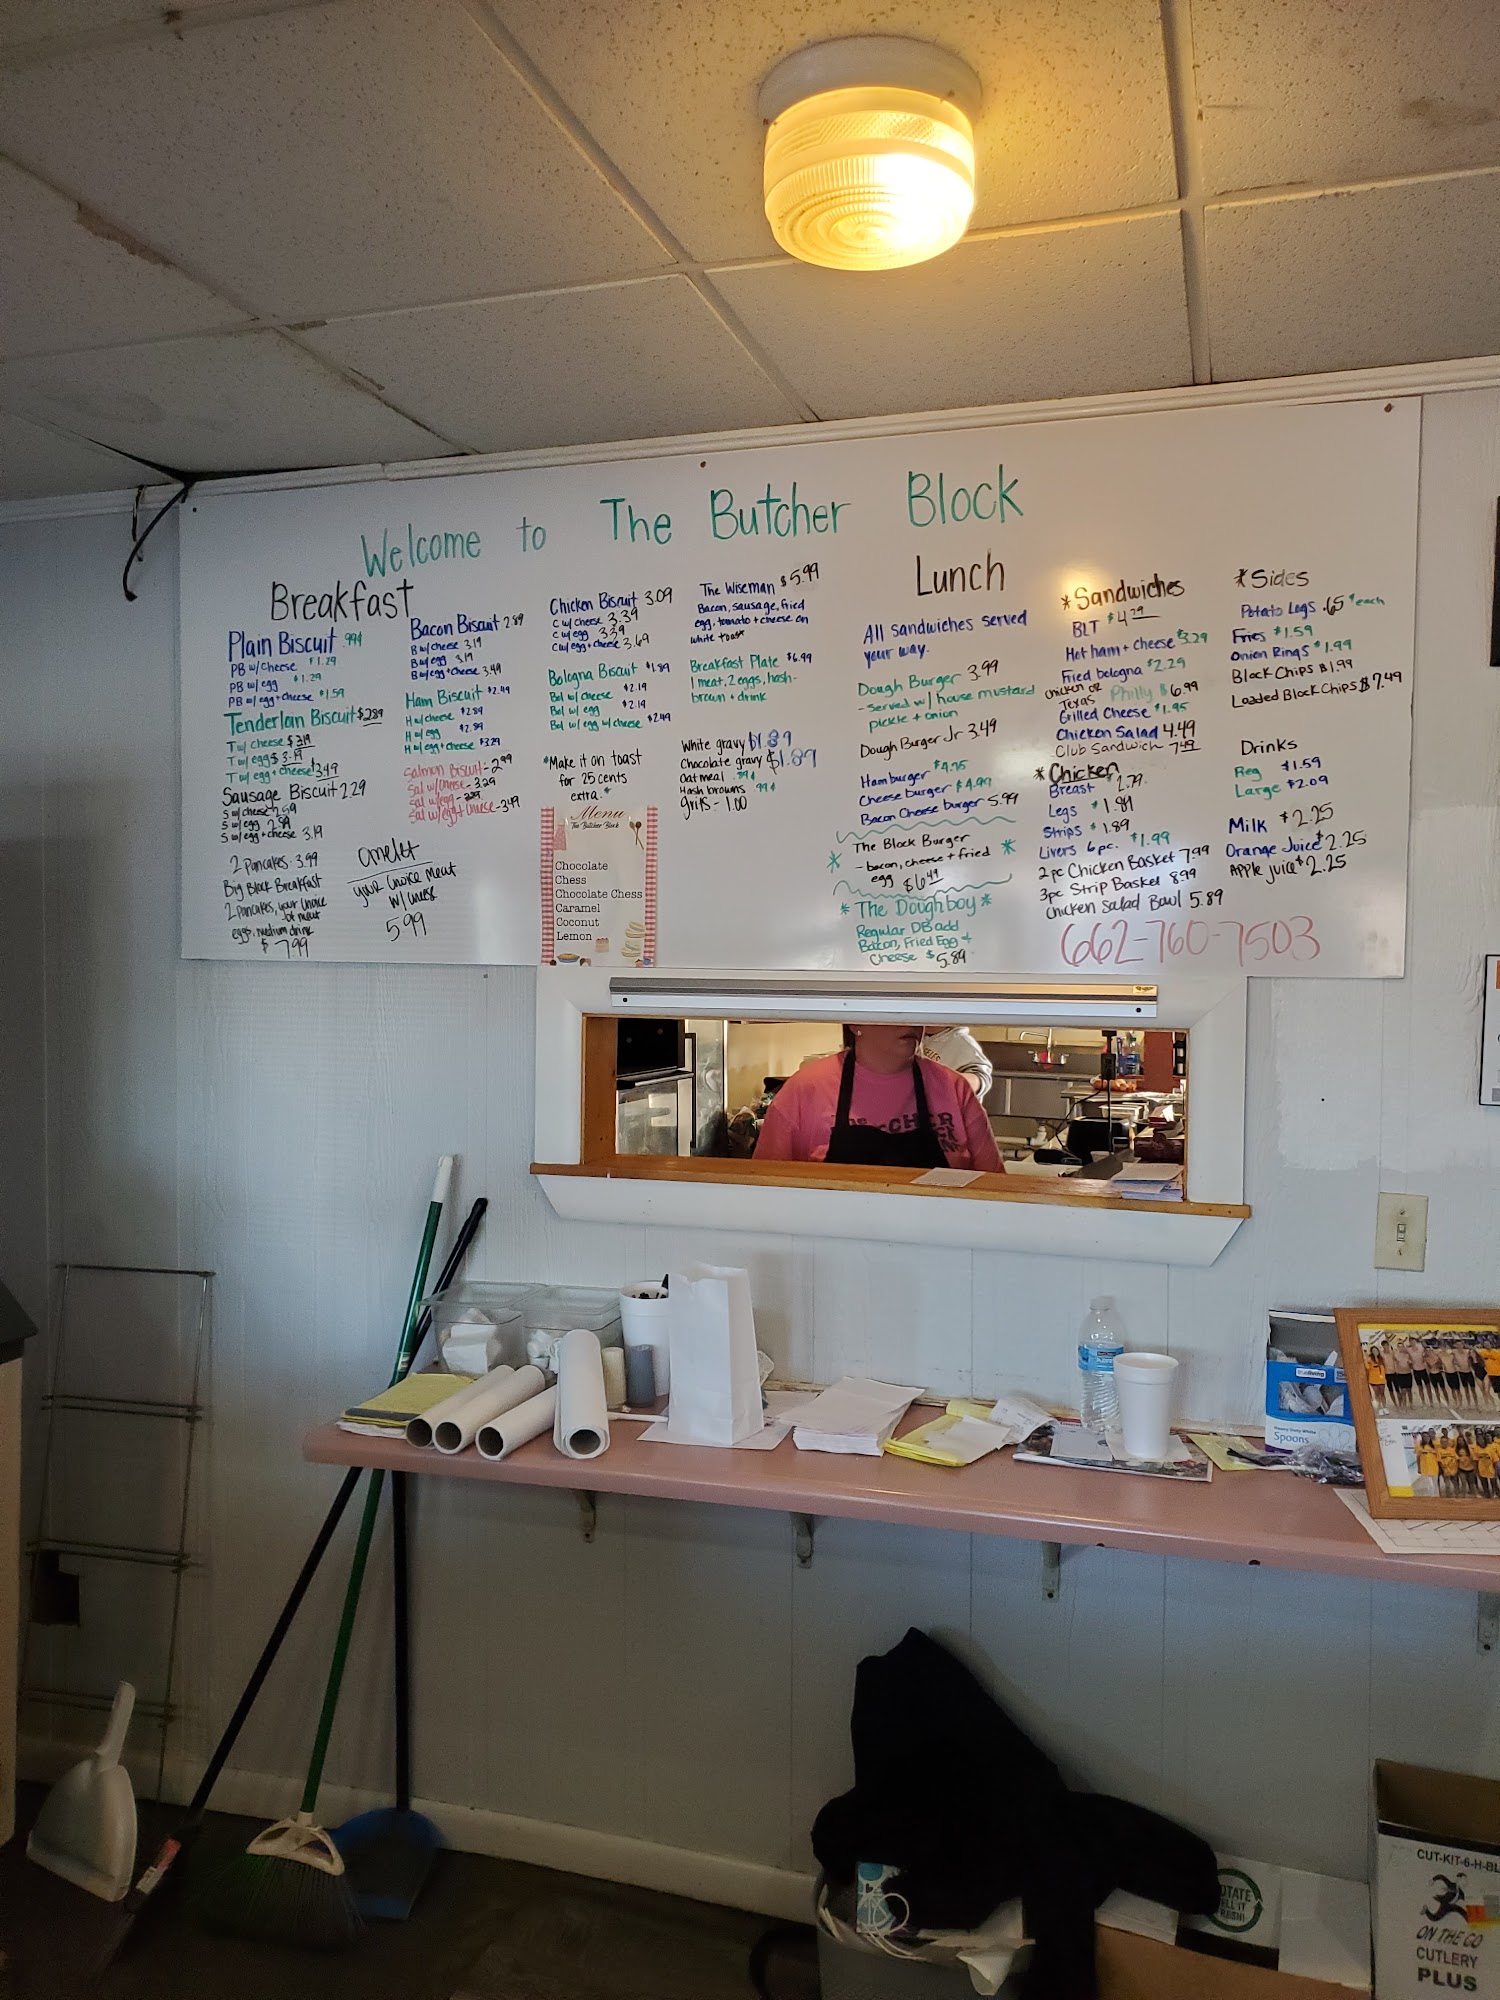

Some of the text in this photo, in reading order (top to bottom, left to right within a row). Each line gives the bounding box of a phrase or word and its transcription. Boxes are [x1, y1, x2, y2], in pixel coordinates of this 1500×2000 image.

[361, 463, 1024, 577] Welcome to The Butcher Block
[915, 548, 1005, 596] Lunch
[699, 582, 775, 597] The Wiseman
[1074, 573, 1185, 611] Sandwiches
[271, 578, 414, 622] Breakfast
[550, 598, 594, 615] Chicken
[599, 591, 638, 609] Biscuit
[781, 598, 805, 611] fried
[411, 618, 453, 640] Bacon
[863, 609, 1028, 644] All sandwiches served
[1072, 620, 1100, 638] BLT
[228, 626, 338, 662] Plain Biscuit
[690, 654, 780, 673] Breakfast Plate
[1275, 662, 1313, 680] Chips
[261, 680, 278, 692] egg
[857, 678, 902, 698] Dough
[909, 673, 962, 692] Burger
[1321, 681, 1357, 695] Chips
[405, 692, 433, 709] Ham
[311, 705, 356, 726] Biscuit
[1115, 725, 1158, 739] Salad
[681, 738, 745, 756] White gravy
[860, 741, 898, 761] Dough
[900, 735, 941, 750] Burger
[943, 725, 963, 742] Jr
[1055, 740, 1164, 758] Club Sandwich
[1241, 739, 1298, 756] Drinks
[579, 748, 643, 767] it on toast
[680, 755, 763, 771] Chocolate gravy
[559, 771, 628, 787] for 25 cents
[1049, 761, 1120, 784] Chicken
[222, 787, 281, 809] Sausage
[289, 780, 338, 800] Biscuit
[1049, 782, 1095, 798] Breast
[1235, 784, 1281, 800] Large
[571, 805, 625, 820] Menu
[1049, 804, 1077, 824] Legs
[1229, 817, 1268, 834] Milk
[853, 833, 971, 853] The Block Burger
[1226, 843, 1277, 859] Orange
[958, 846, 991, 860] fried
[555, 861, 608, 871] Chocolate
[1068, 861, 1124, 879] Chicken
[1128, 852, 1176, 871] Basket
[223, 880, 244, 901] Big
[276, 873, 322, 893] Breakfast
[555, 875, 587, 885] Chess
[870, 874, 894, 888] egg
[1069, 876, 1160, 897] Strip Basket
[555, 889, 643, 899] Chocolate Chess
[555, 903, 600, 913] Caramel
[854, 900, 888, 919] The
[556, 917, 600, 927] Coconut
[856, 924, 905, 942] Regular
[935, 920, 959, 932] add
[557, 931, 592, 941] Lemon
[904, 935, 958, 949] Fried Egg
[870, 953, 917, 966] Cheese
[1274, 1432, 1309, 1443] Spoons
[1417, 1925, 1437, 1941] ON
[1440, 1930, 1465, 1946] THE
[1416, 1946, 1479, 1969] CUTLERY
[1418, 1966, 1477, 1992] PLUS
